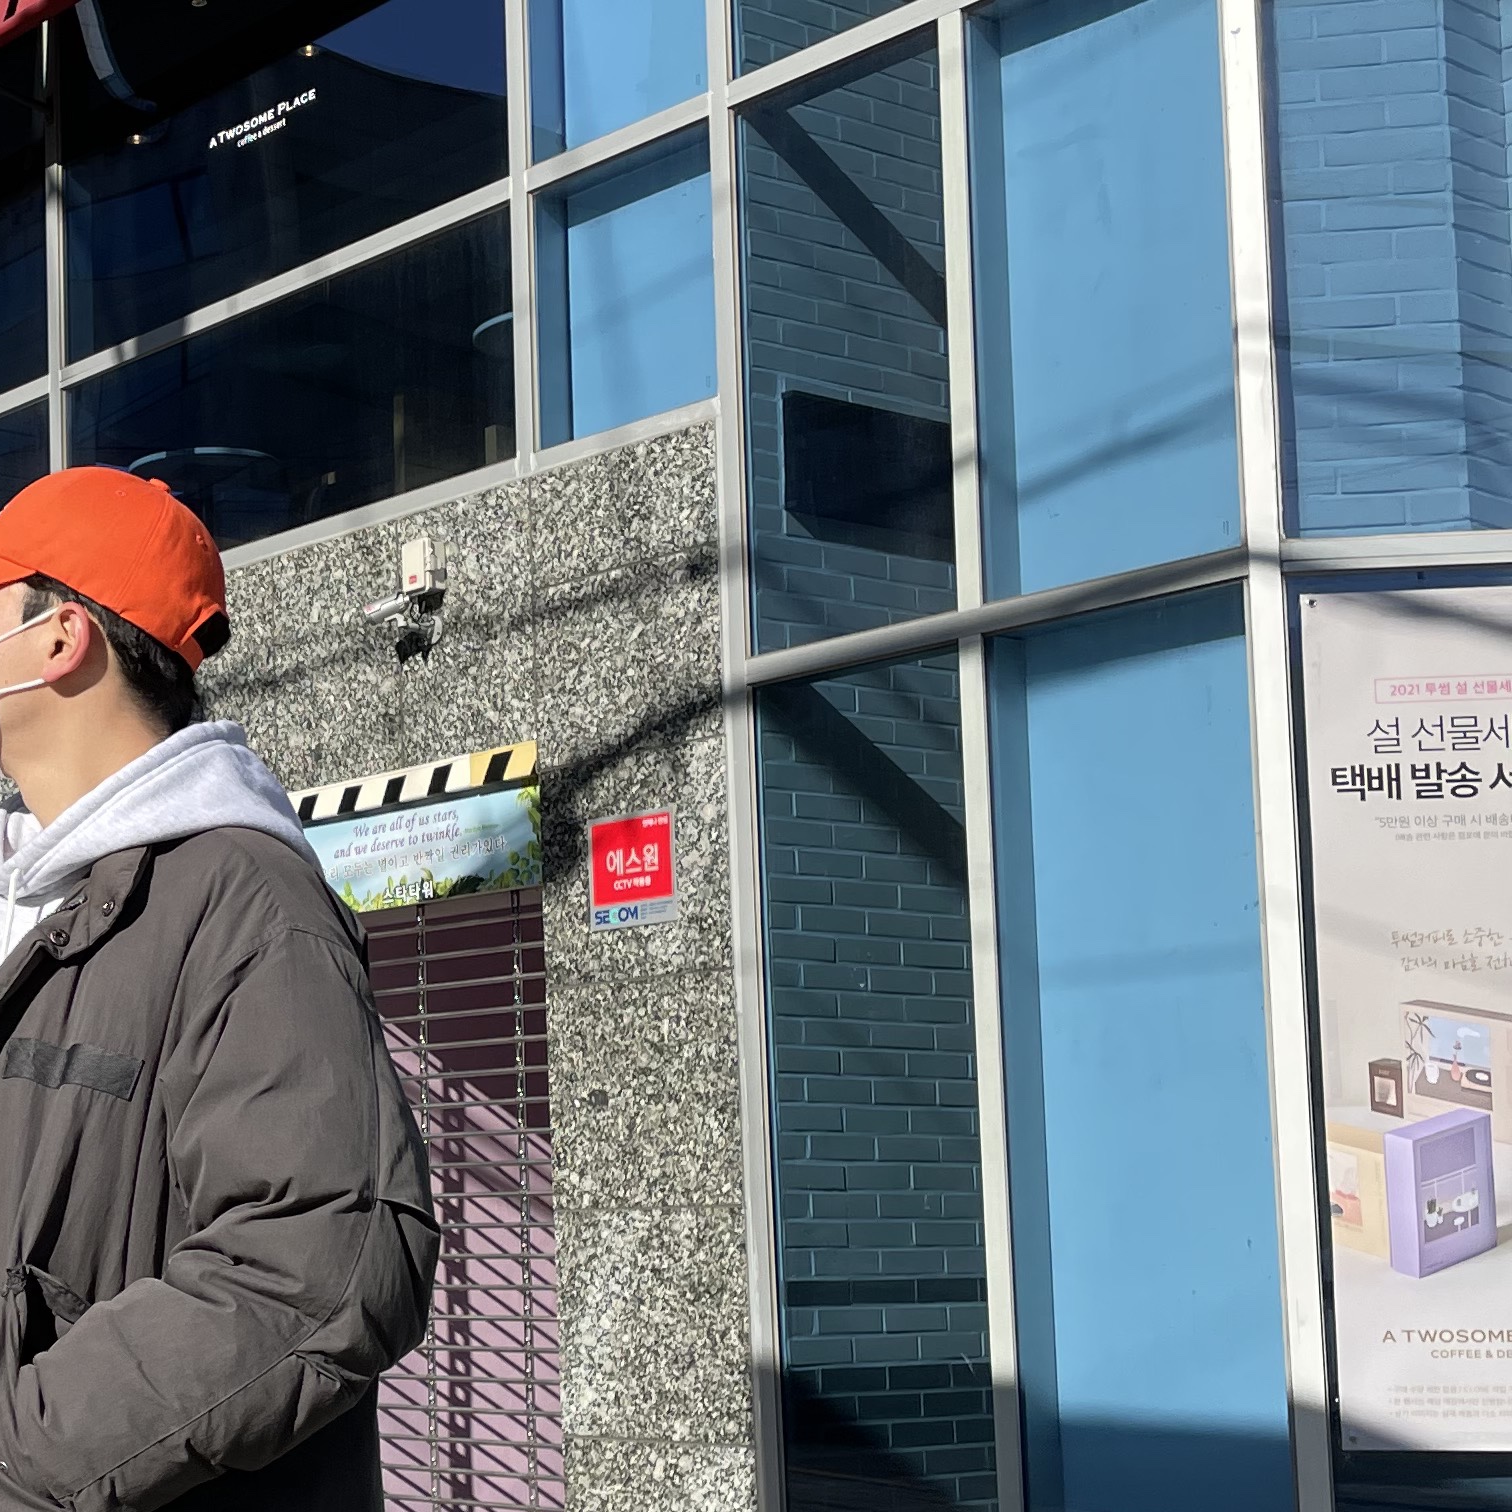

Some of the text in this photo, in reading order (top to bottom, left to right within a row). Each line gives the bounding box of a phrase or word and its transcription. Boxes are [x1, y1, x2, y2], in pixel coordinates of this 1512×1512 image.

[277, 88, 317, 116] PLACE
[1390, 684, 1420, 696] 2021
[1425, 682, 1451, 696] 투썸
[1455, 680, 1468, 695] 설
[1366, 716, 1403, 754] 설
[1330, 762, 1403, 802] 택배
[1410, 761, 1483, 800] 발송
[353, 809, 459, 838] We are all of us stars,
[1414, 814, 1438, 828] 이상
[1442, 814, 1467, 827] 구매
[1470, 813, 1482, 826] 시
[1485, 812, 1512, 826] 배송
[334, 842, 353, 859] and
[354, 844, 367, 857] we
[370, 838, 405, 853] deserve
[408, 835, 419, 846] to
[605, 843, 660, 877] 에스원
[381, 880, 434, 905] 스타타워
[594, 905, 639, 926] SECOM
[1382, 1329, 1512, 1343] A TWOSOME
[1430, 1349, 1482, 1359] COFFEE
